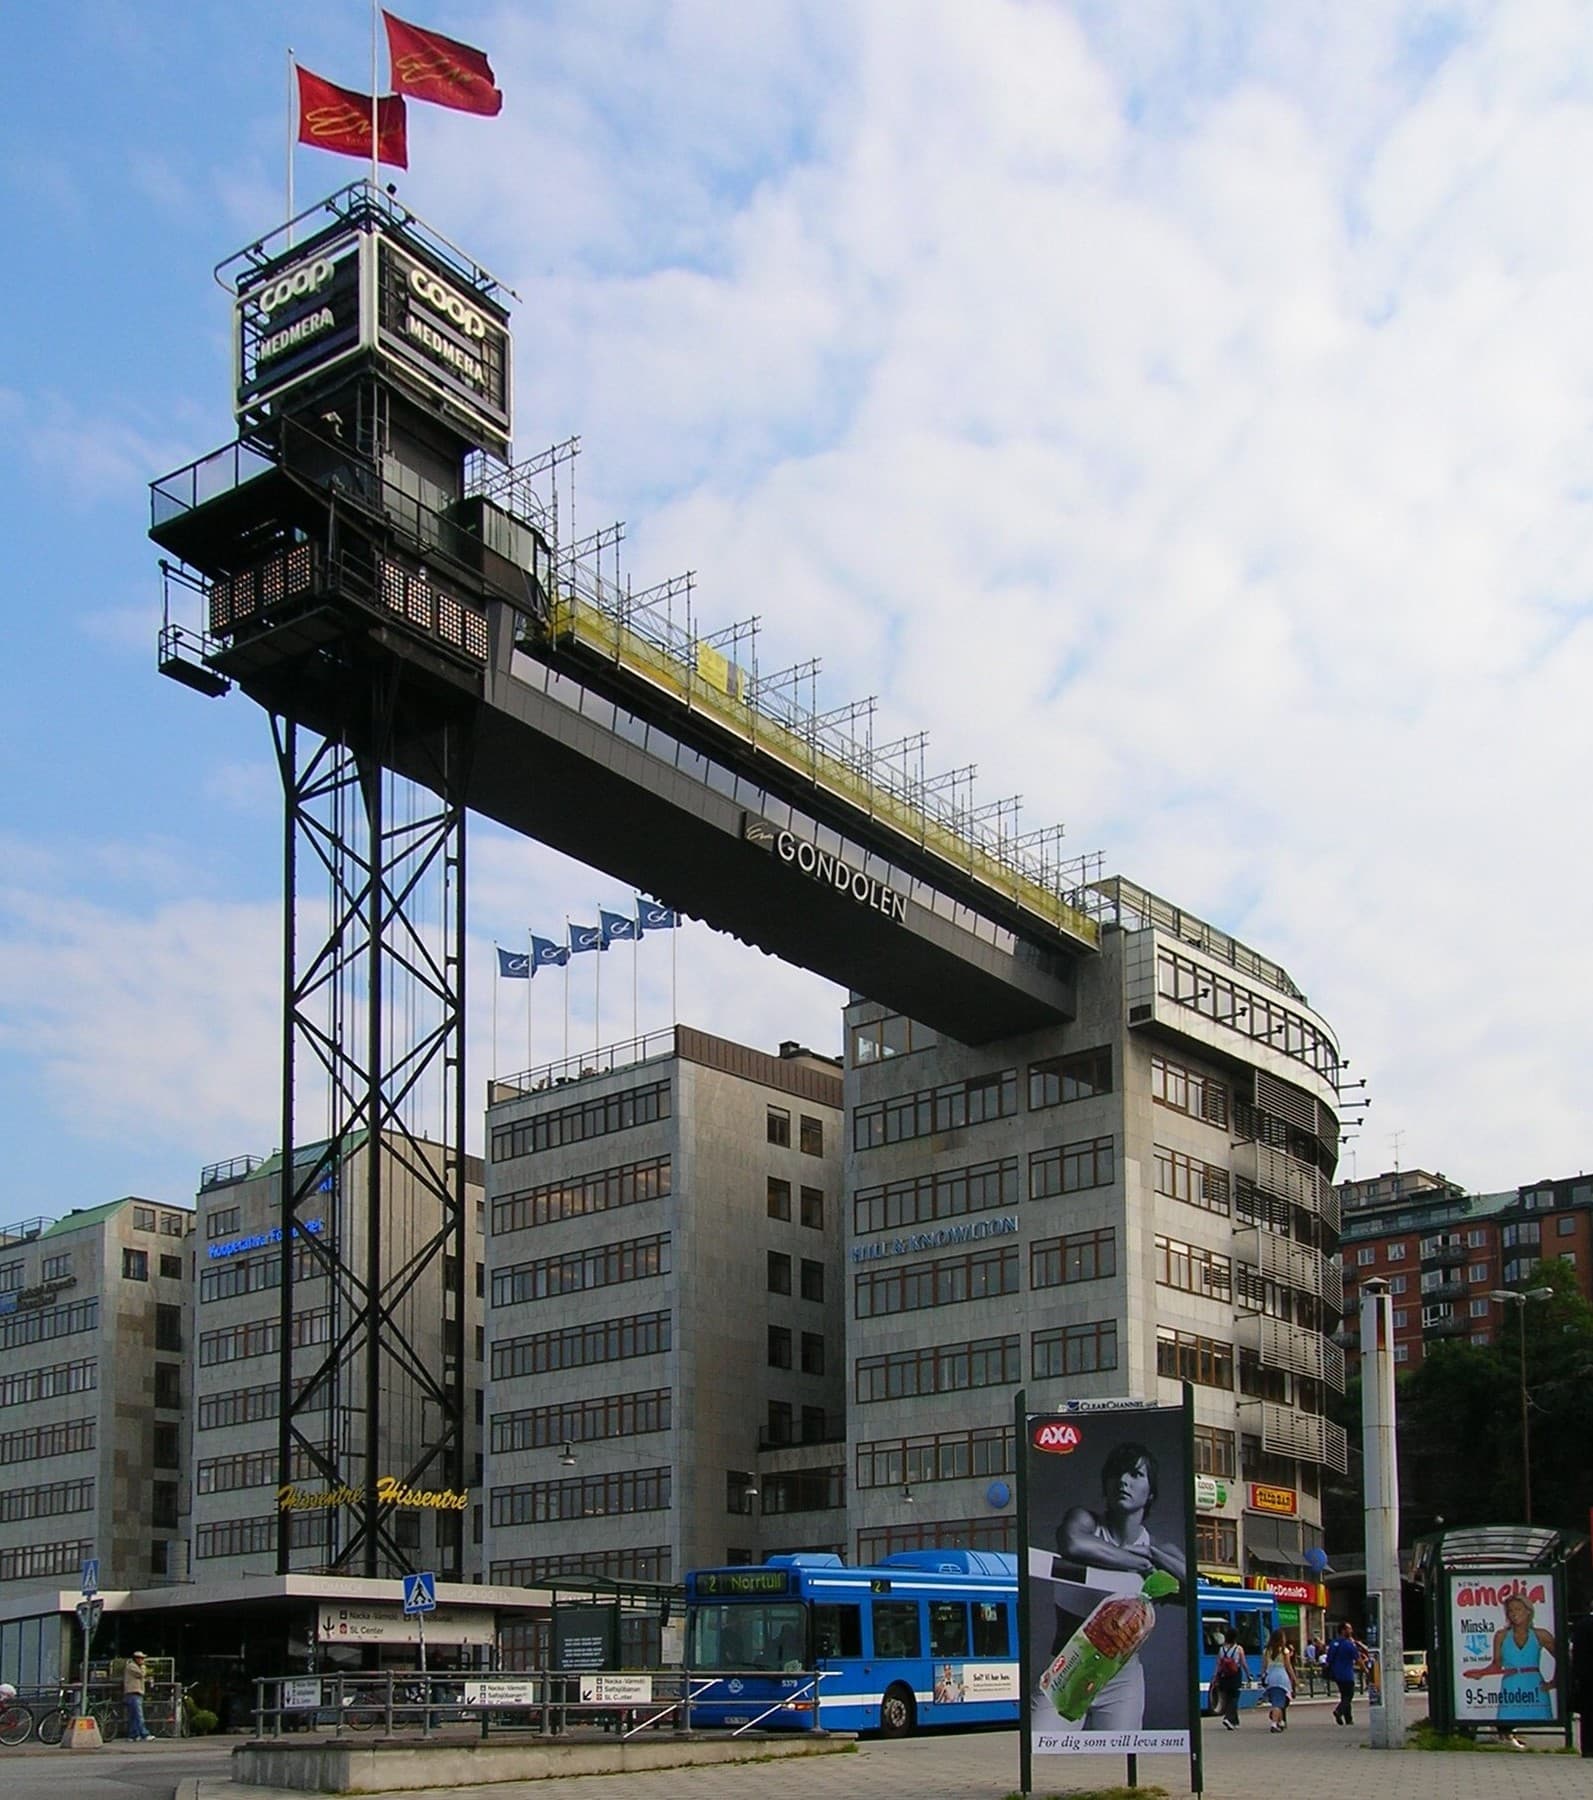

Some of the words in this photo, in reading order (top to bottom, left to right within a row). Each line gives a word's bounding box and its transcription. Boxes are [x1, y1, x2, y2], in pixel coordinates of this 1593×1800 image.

[259, 307, 335, 360] MEDMERA
[407, 313, 486, 384] MEDMERA
[778, 831, 908, 922] GONDOLEN
[849, 1241, 887, 1263] HILL
[893, 1238, 907, 1255] &
[907, 1215, 1019, 1252] KNOWLTON
[1039, 1426, 1078, 1444] AXA
[377, 1475, 470, 1511] Hissentré
[709, 1575, 717, 1592] 2
[731, 1574, 784, 1590] Norrtull
[873, 1581, 881, 1593] 2
[1266, 1583, 1308, 1599] McDonald's
[1457, 1579, 1546, 1607] amelia
[361, 1625, 384, 1634] Center
[1460, 1619, 1495, 1634] Minska
[1465, 1687, 1539, 1705] 9-5-metoden!
[1037, 1736, 1057, 1748] För
[1061, 1736, 1080, 1750] dig
[1084, 1738, 1106, 1748] som
[1110, 1735, 1131, 1747] vill
[1133, 1735, 1157, 1747] leva
[1160, 1736, 1184, 1748] sunt
